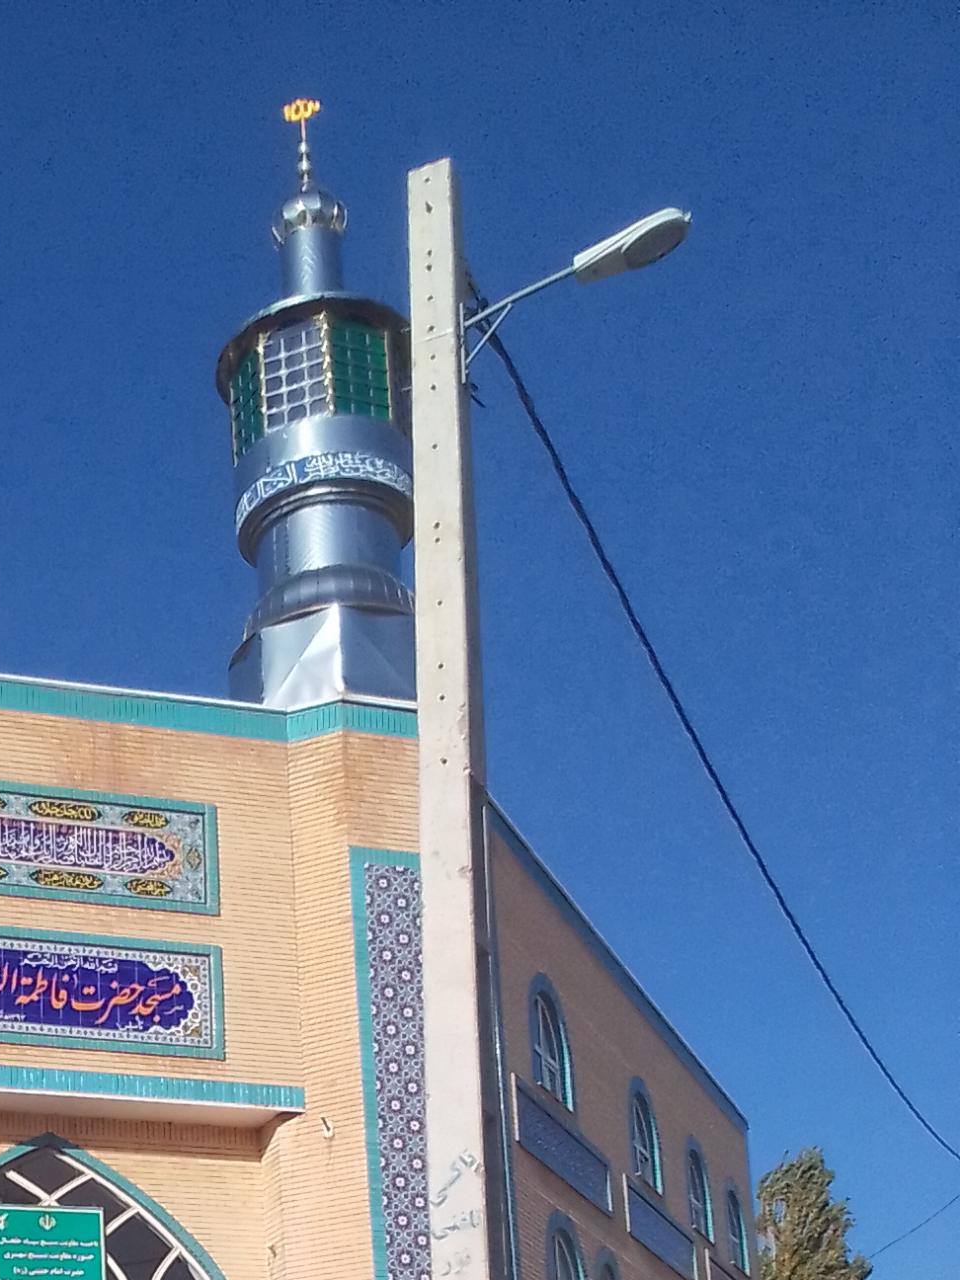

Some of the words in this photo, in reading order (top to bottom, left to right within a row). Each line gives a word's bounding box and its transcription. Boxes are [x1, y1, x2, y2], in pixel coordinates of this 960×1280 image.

[71, 980, 145, 1024] حضرت
[128, 976, 182, 1022] مسجد
[40, 1238, 58, 1247] بسیج
[59, 1239, 79, 1248] مقاومت
[27, 1251, 48, 1260] بسیج
[48, 1251, 72, 1260] مقاومت
[50, 1267, 64, 1275] امام
[64, 1269, 85, 1277] حضرت
